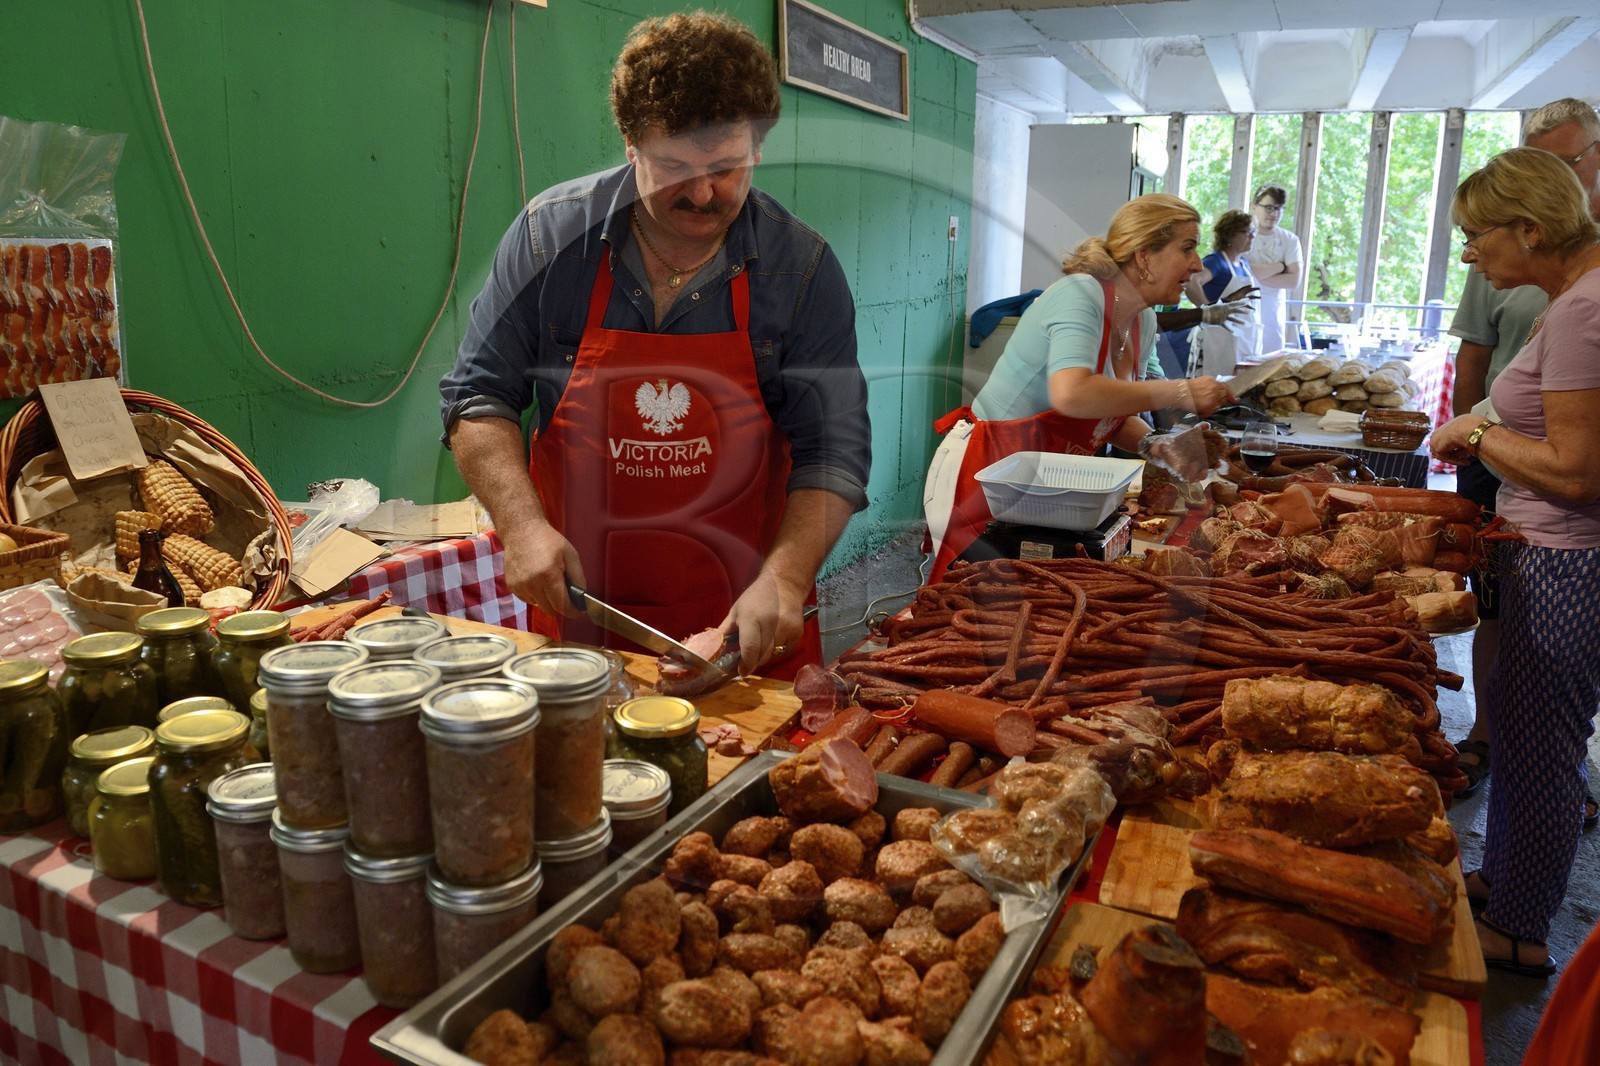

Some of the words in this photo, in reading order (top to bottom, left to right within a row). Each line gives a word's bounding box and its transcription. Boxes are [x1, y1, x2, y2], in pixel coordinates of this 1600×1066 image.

[823, 43, 849, 74] HEALTHY
[851, 55, 871, 82] BREAD
[615, 462, 664, 478] Polish
[669, 461, 706, 477] Meat
